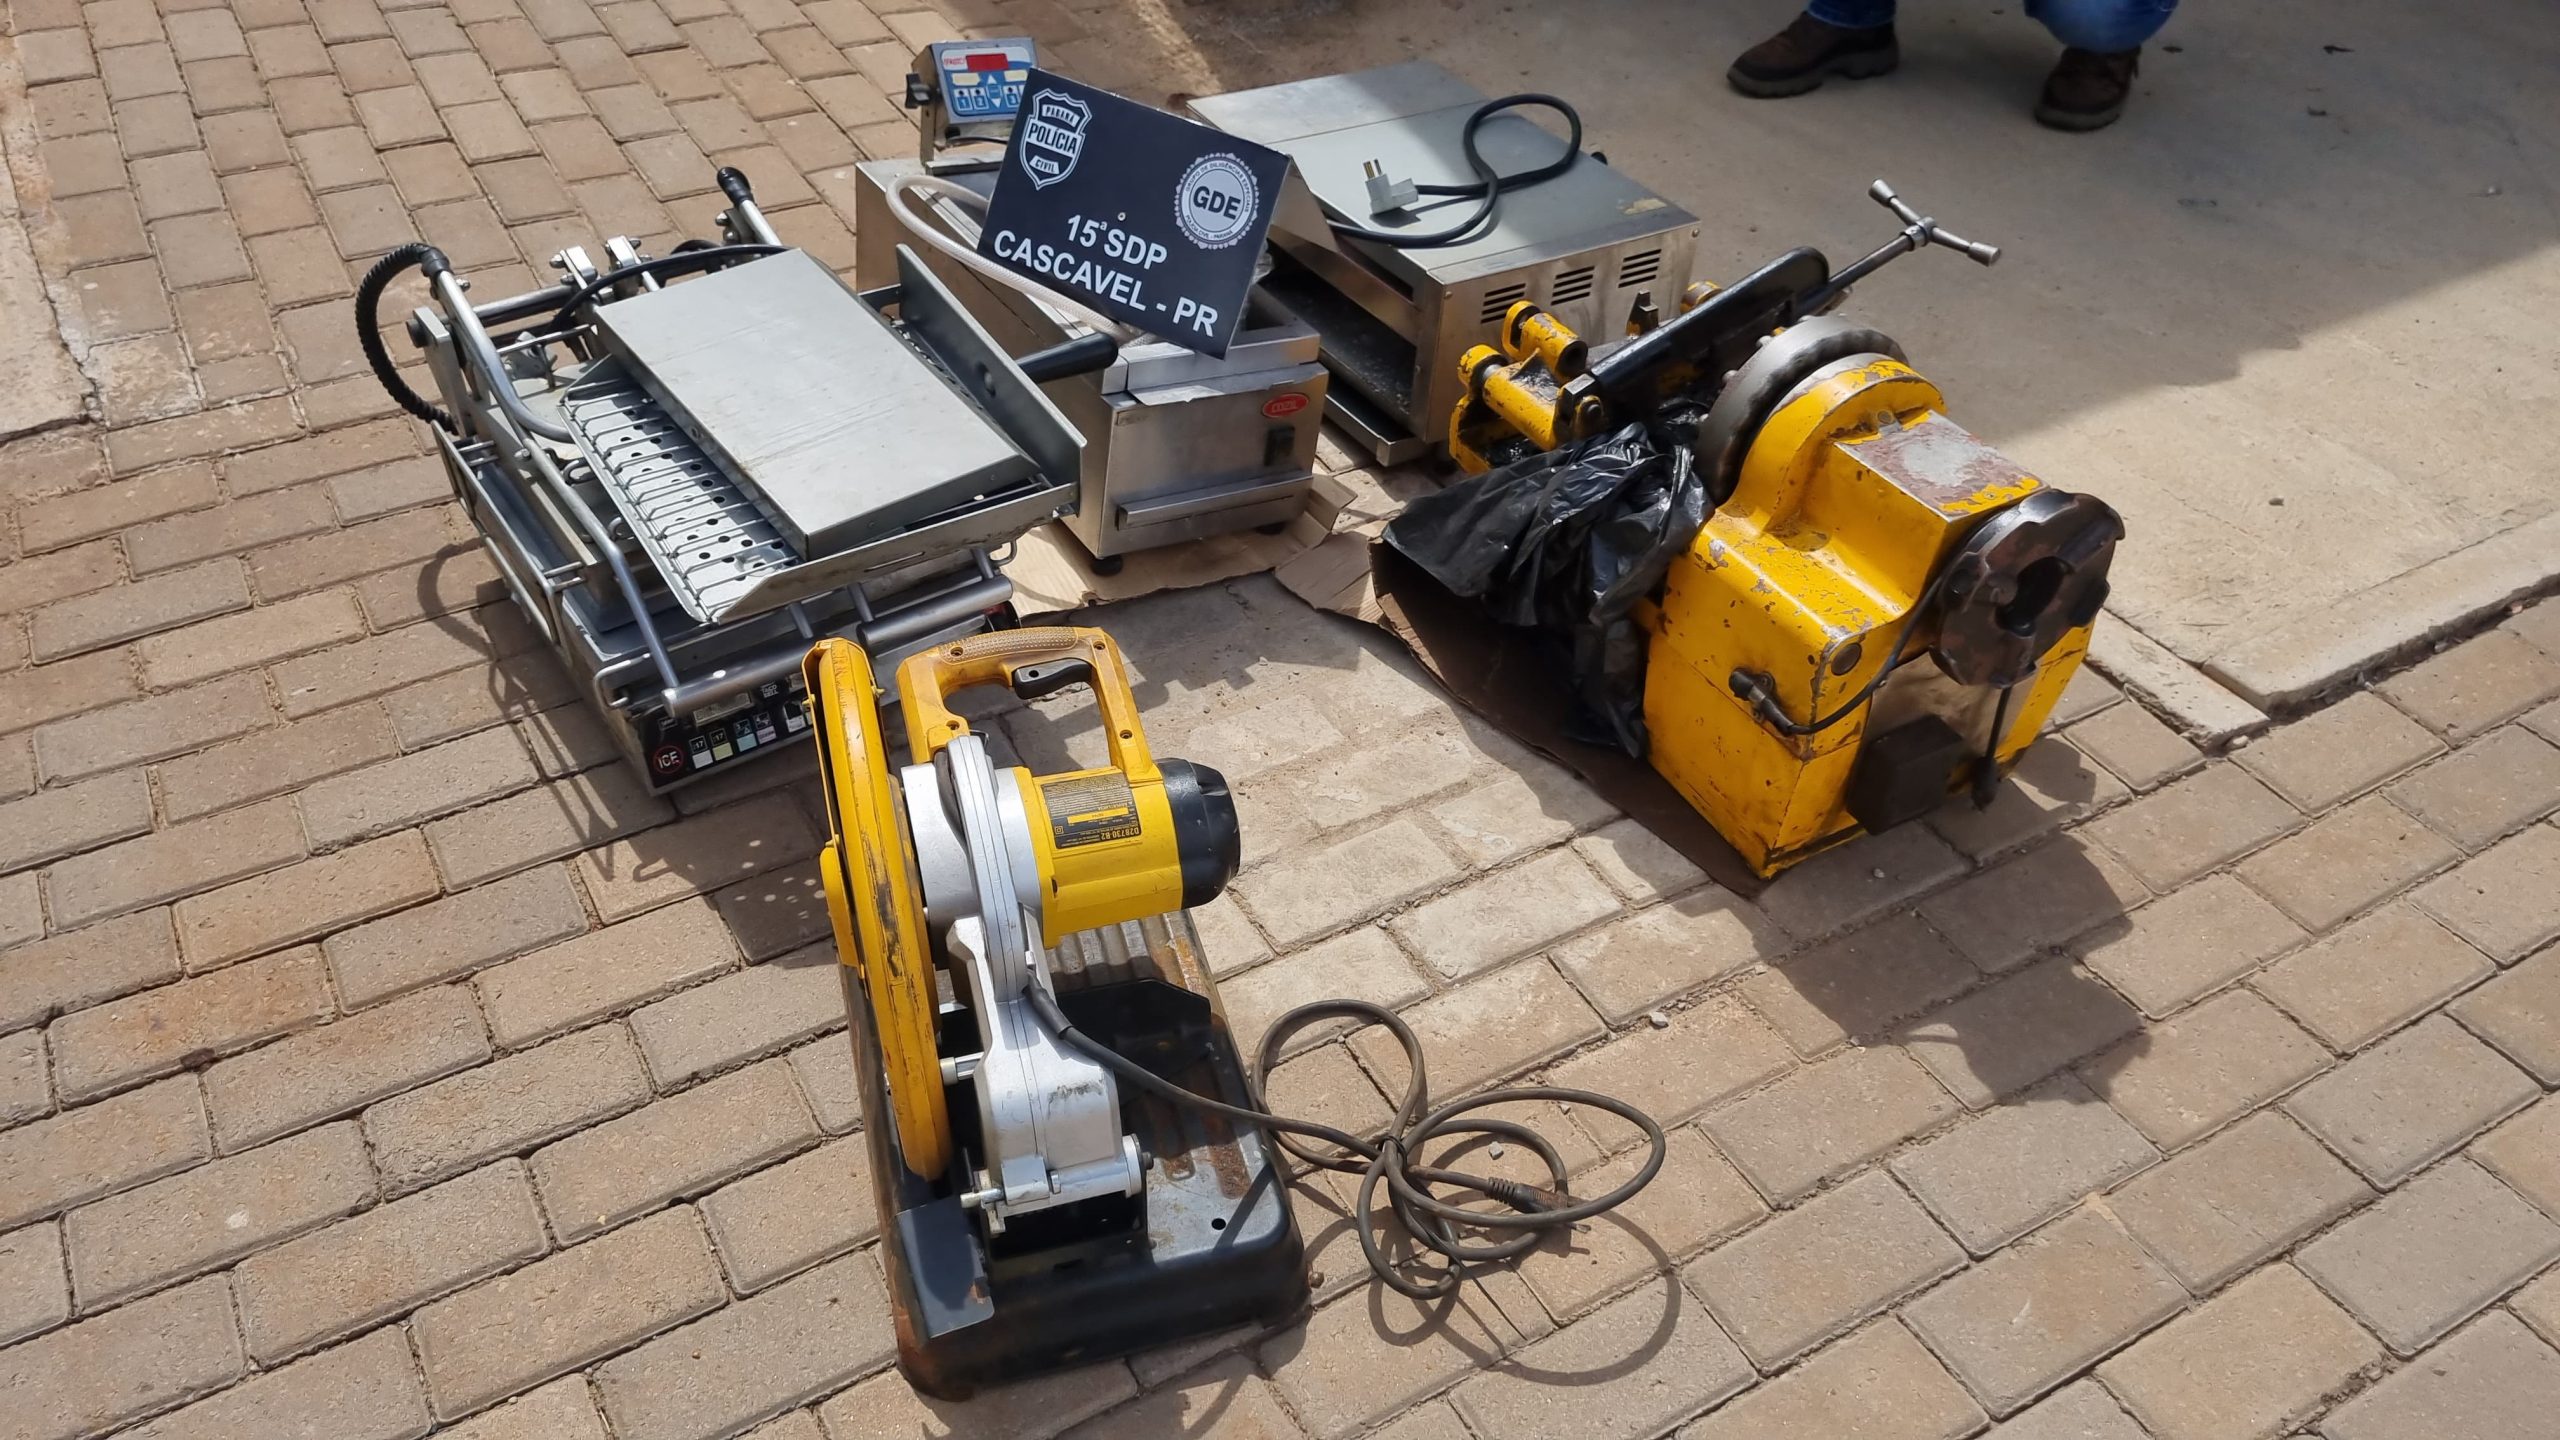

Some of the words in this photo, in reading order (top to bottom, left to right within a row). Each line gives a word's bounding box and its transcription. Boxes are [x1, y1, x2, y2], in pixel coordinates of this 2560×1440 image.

[1028, 122, 1077, 154] POLÍCIA
[1035, 159, 1056, 173] CIVIL
[1186, 171, 1201, 192] GRUPO
[1201, 166, 1209, 175] DE
[1241, 178, 1252, 213] ESPECIAIS
[1193, 185, 1241, 220] GDE
[1103, 228, 1168, 270] SDP
[993, 229, 1147, 312] CASCAVEL
[1155, 302, 1167, 312] -
[1172, 296, 1218, 337] PR
[658, 751, 679, 769] ICE
